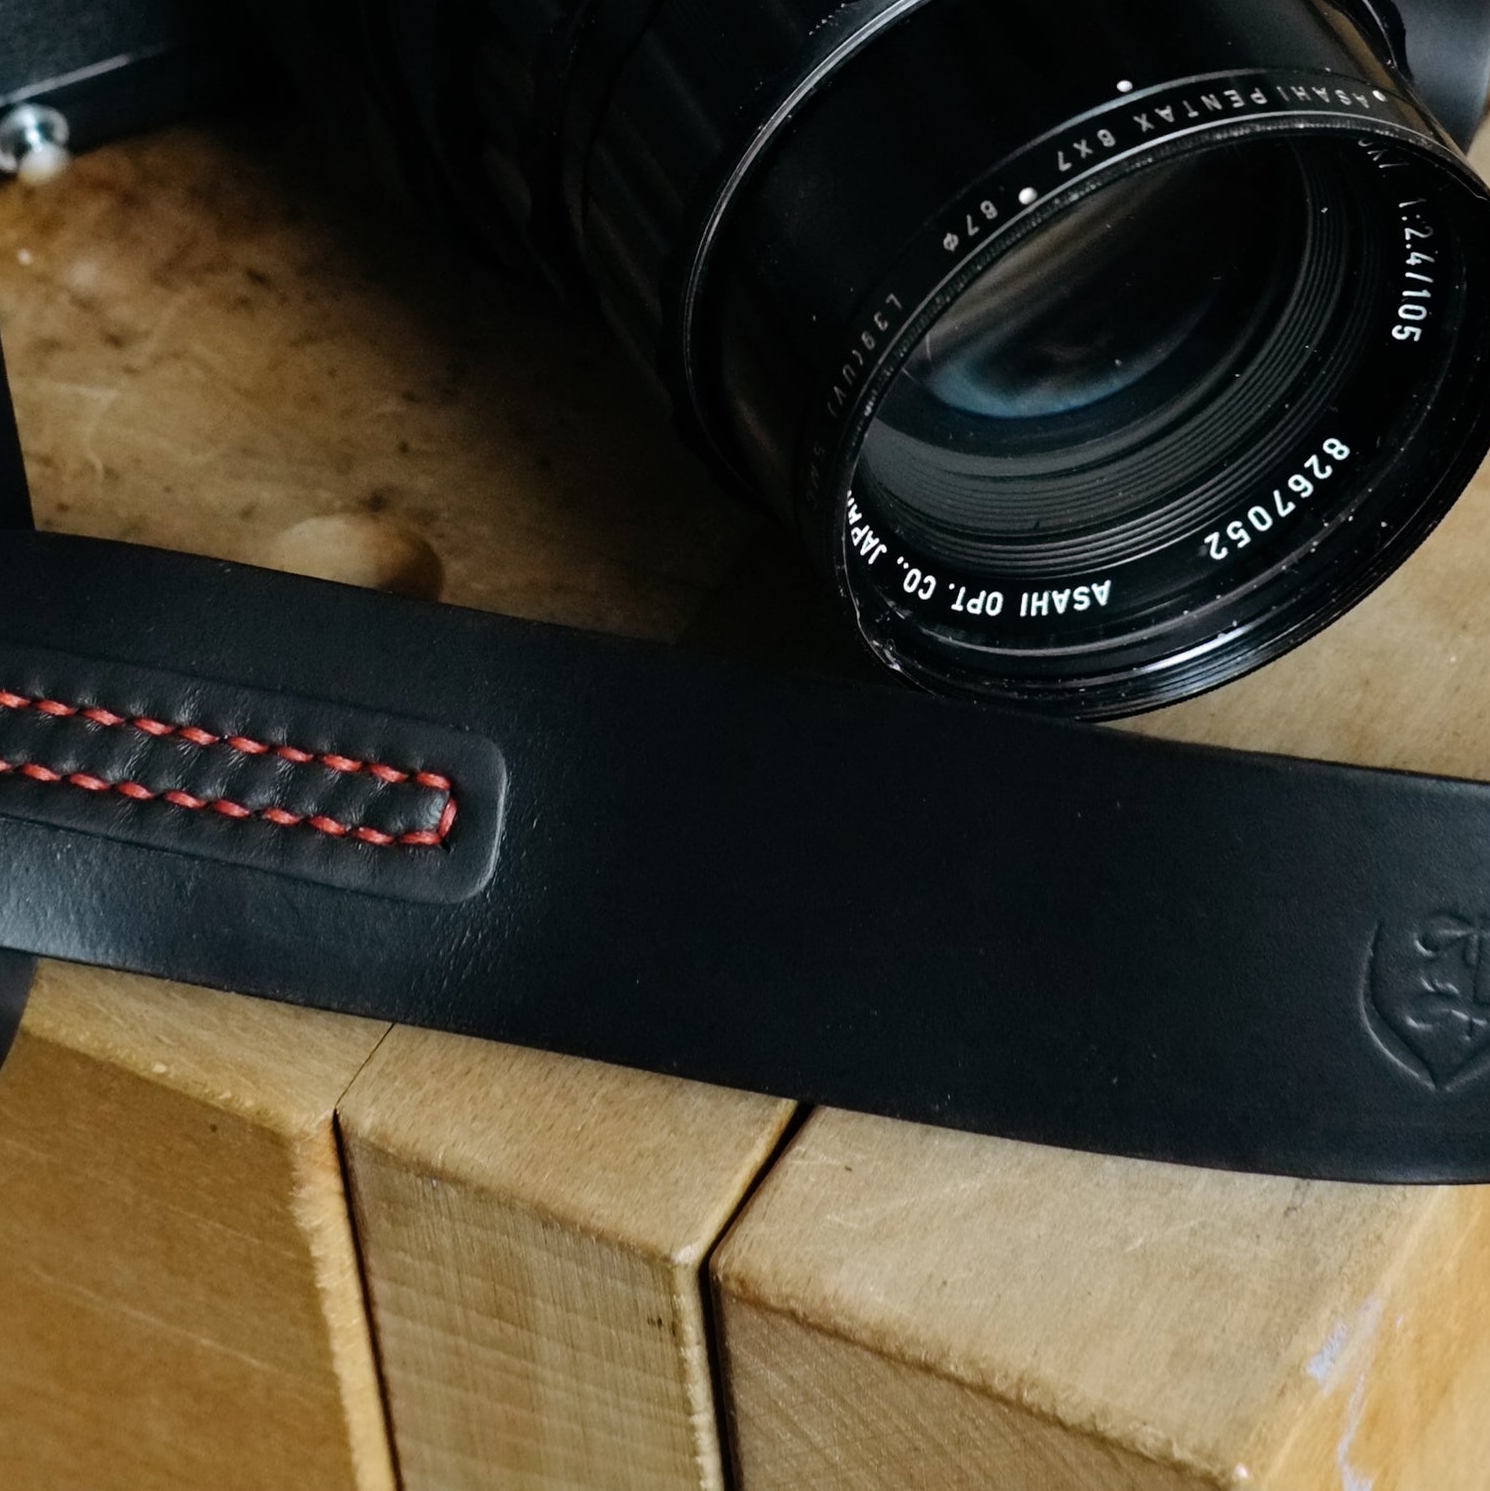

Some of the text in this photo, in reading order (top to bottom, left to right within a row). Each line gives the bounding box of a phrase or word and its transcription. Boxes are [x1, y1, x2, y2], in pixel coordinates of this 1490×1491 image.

[1133, 87, 1268, 132] PENTAX
[1275, 85, 1371, 110] ASAHI
[1203, 437, 1351, 560] 8267052
[948, 583, 1004, 617] OPT.
[1019, 579, 1112, 617] ASAHI
